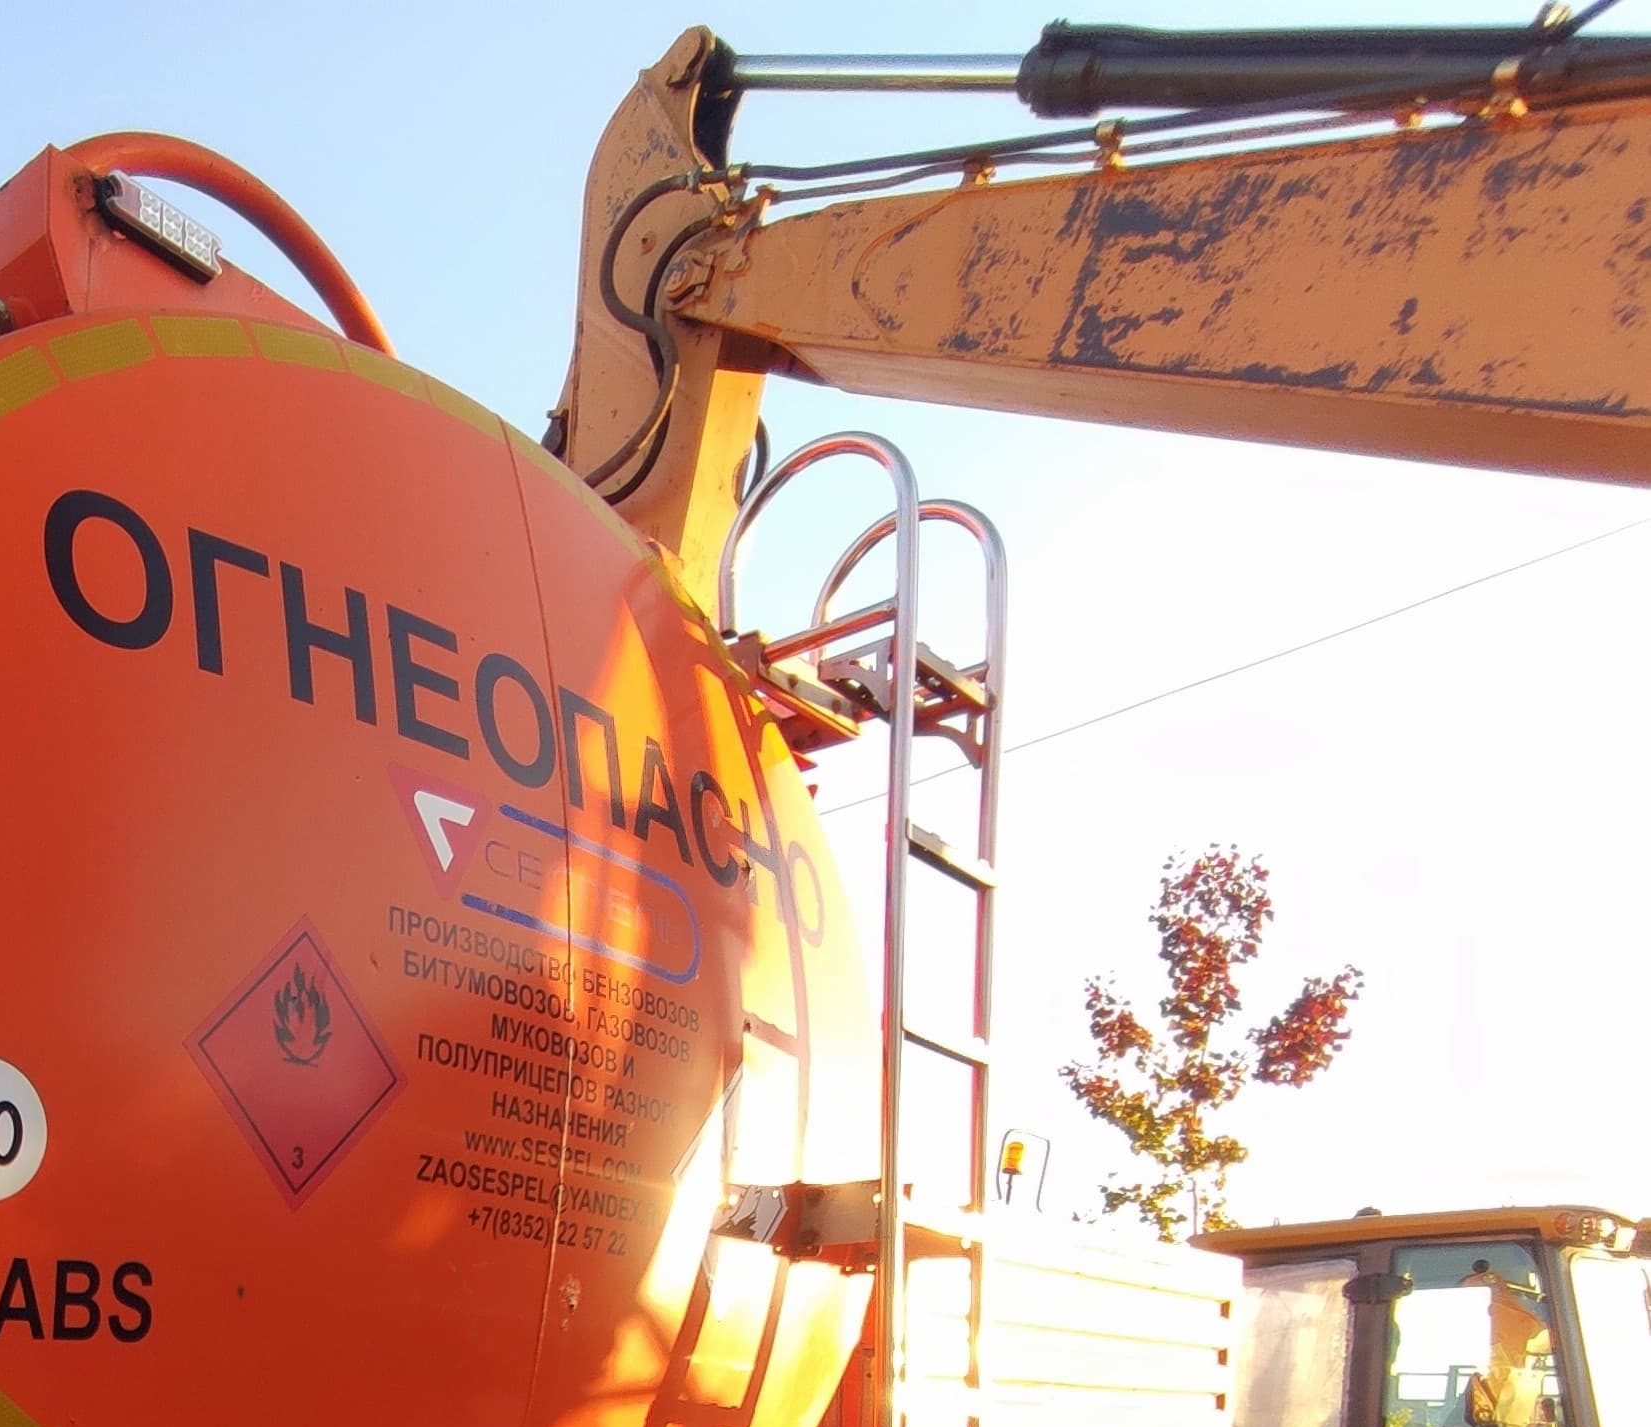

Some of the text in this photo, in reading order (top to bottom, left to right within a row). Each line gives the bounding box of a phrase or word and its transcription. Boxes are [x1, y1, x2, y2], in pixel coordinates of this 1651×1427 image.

[44, 489, 825, 947] ОГНЕОПАСНО
[389, 906, 575, 986] ПРОИЗВОДСТВО
[403, 950, 581, 1030] БИТУМОВОЗОВ,
[417, 1032, 598, 1103] ПОЛУПРИЦЕПОВ
[491, 1013, 635, 1079] МУКОВОЗОВ И
[292, 1146, 305, 1170] 3
[467, 1205, 629, 1257] +7(8352) 22 57 22
